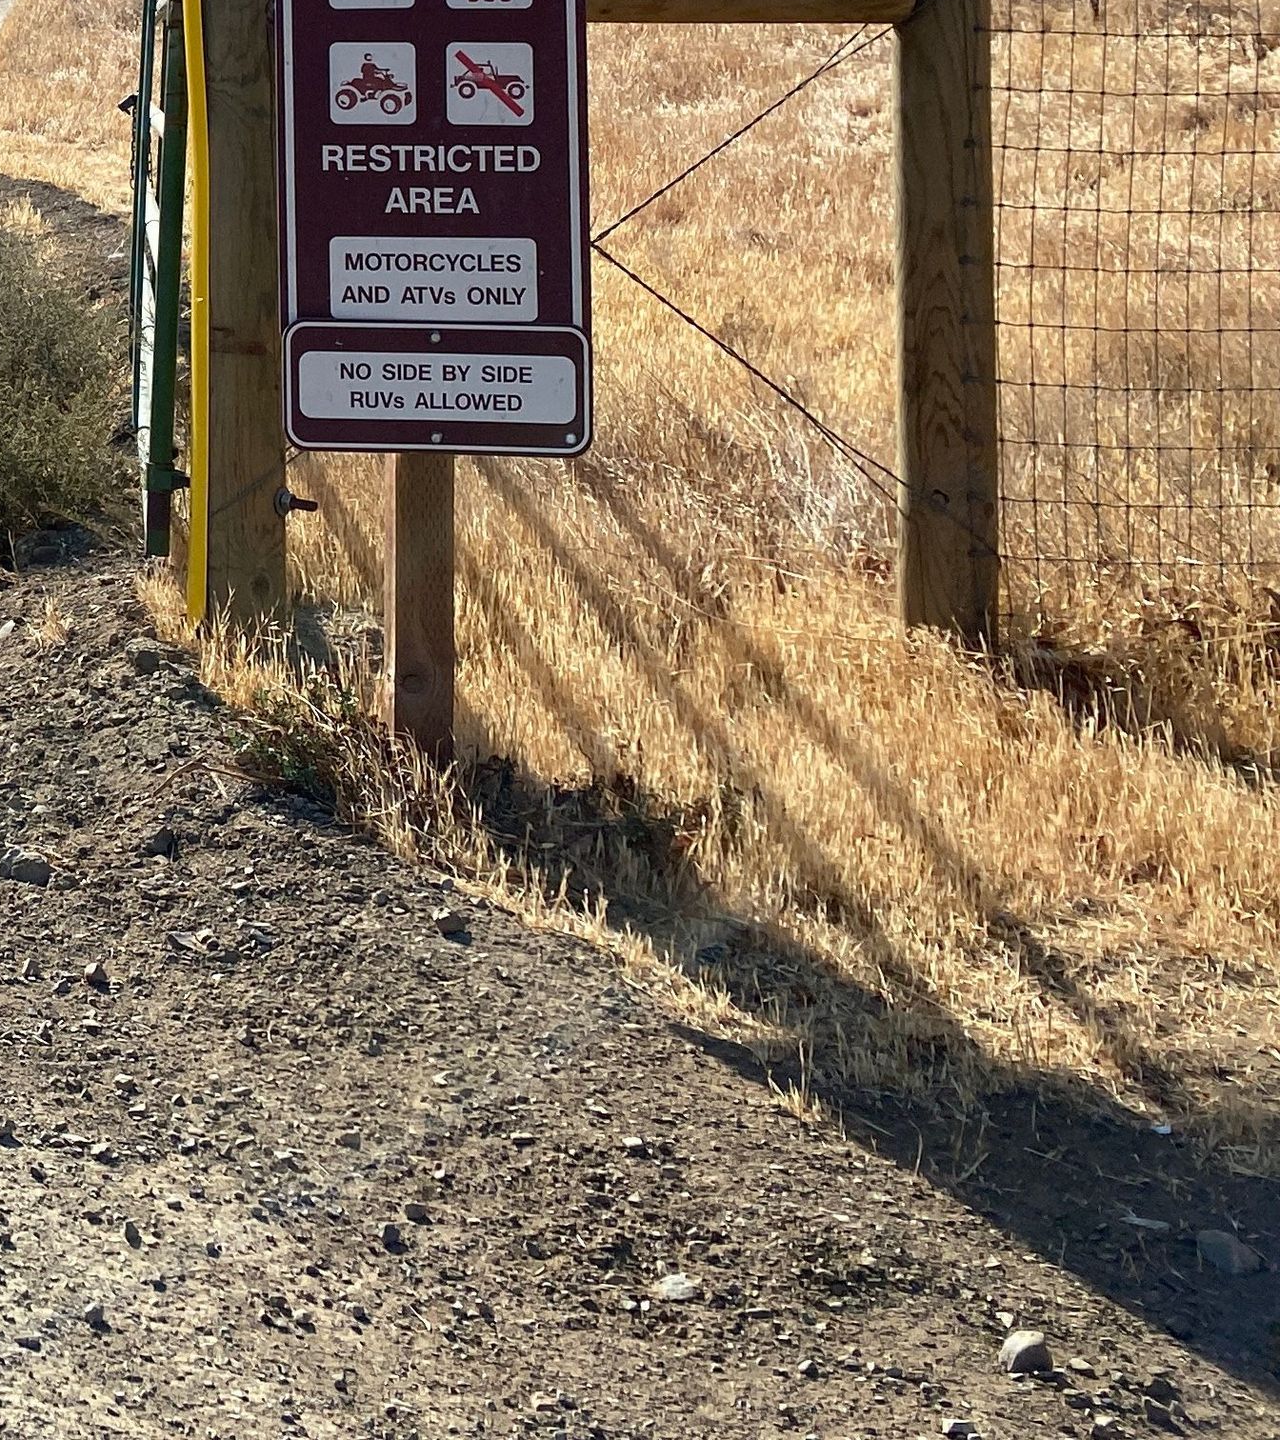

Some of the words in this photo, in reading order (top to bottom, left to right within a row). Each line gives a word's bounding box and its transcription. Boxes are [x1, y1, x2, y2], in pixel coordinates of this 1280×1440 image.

[322, 145, 540, 172] RESTRICTED
[385, 187, 480, 214] AREA
[344, 253, 522, 273] MOTORCYCLES
[341, 286, 390, 303] AND
[401, 287, 456, 304] ATVs
[467, 287, 526, 305] ONLY
[340, 363, 371, 380] NO
[382, 364, 432, 381] SIDE
[442, 365, 471, 381] BY
[481, 366, 532, 383] SIDE
[350, 392, 405, 408] RUVs
[414, 393, 522, 411] ALLOWED
